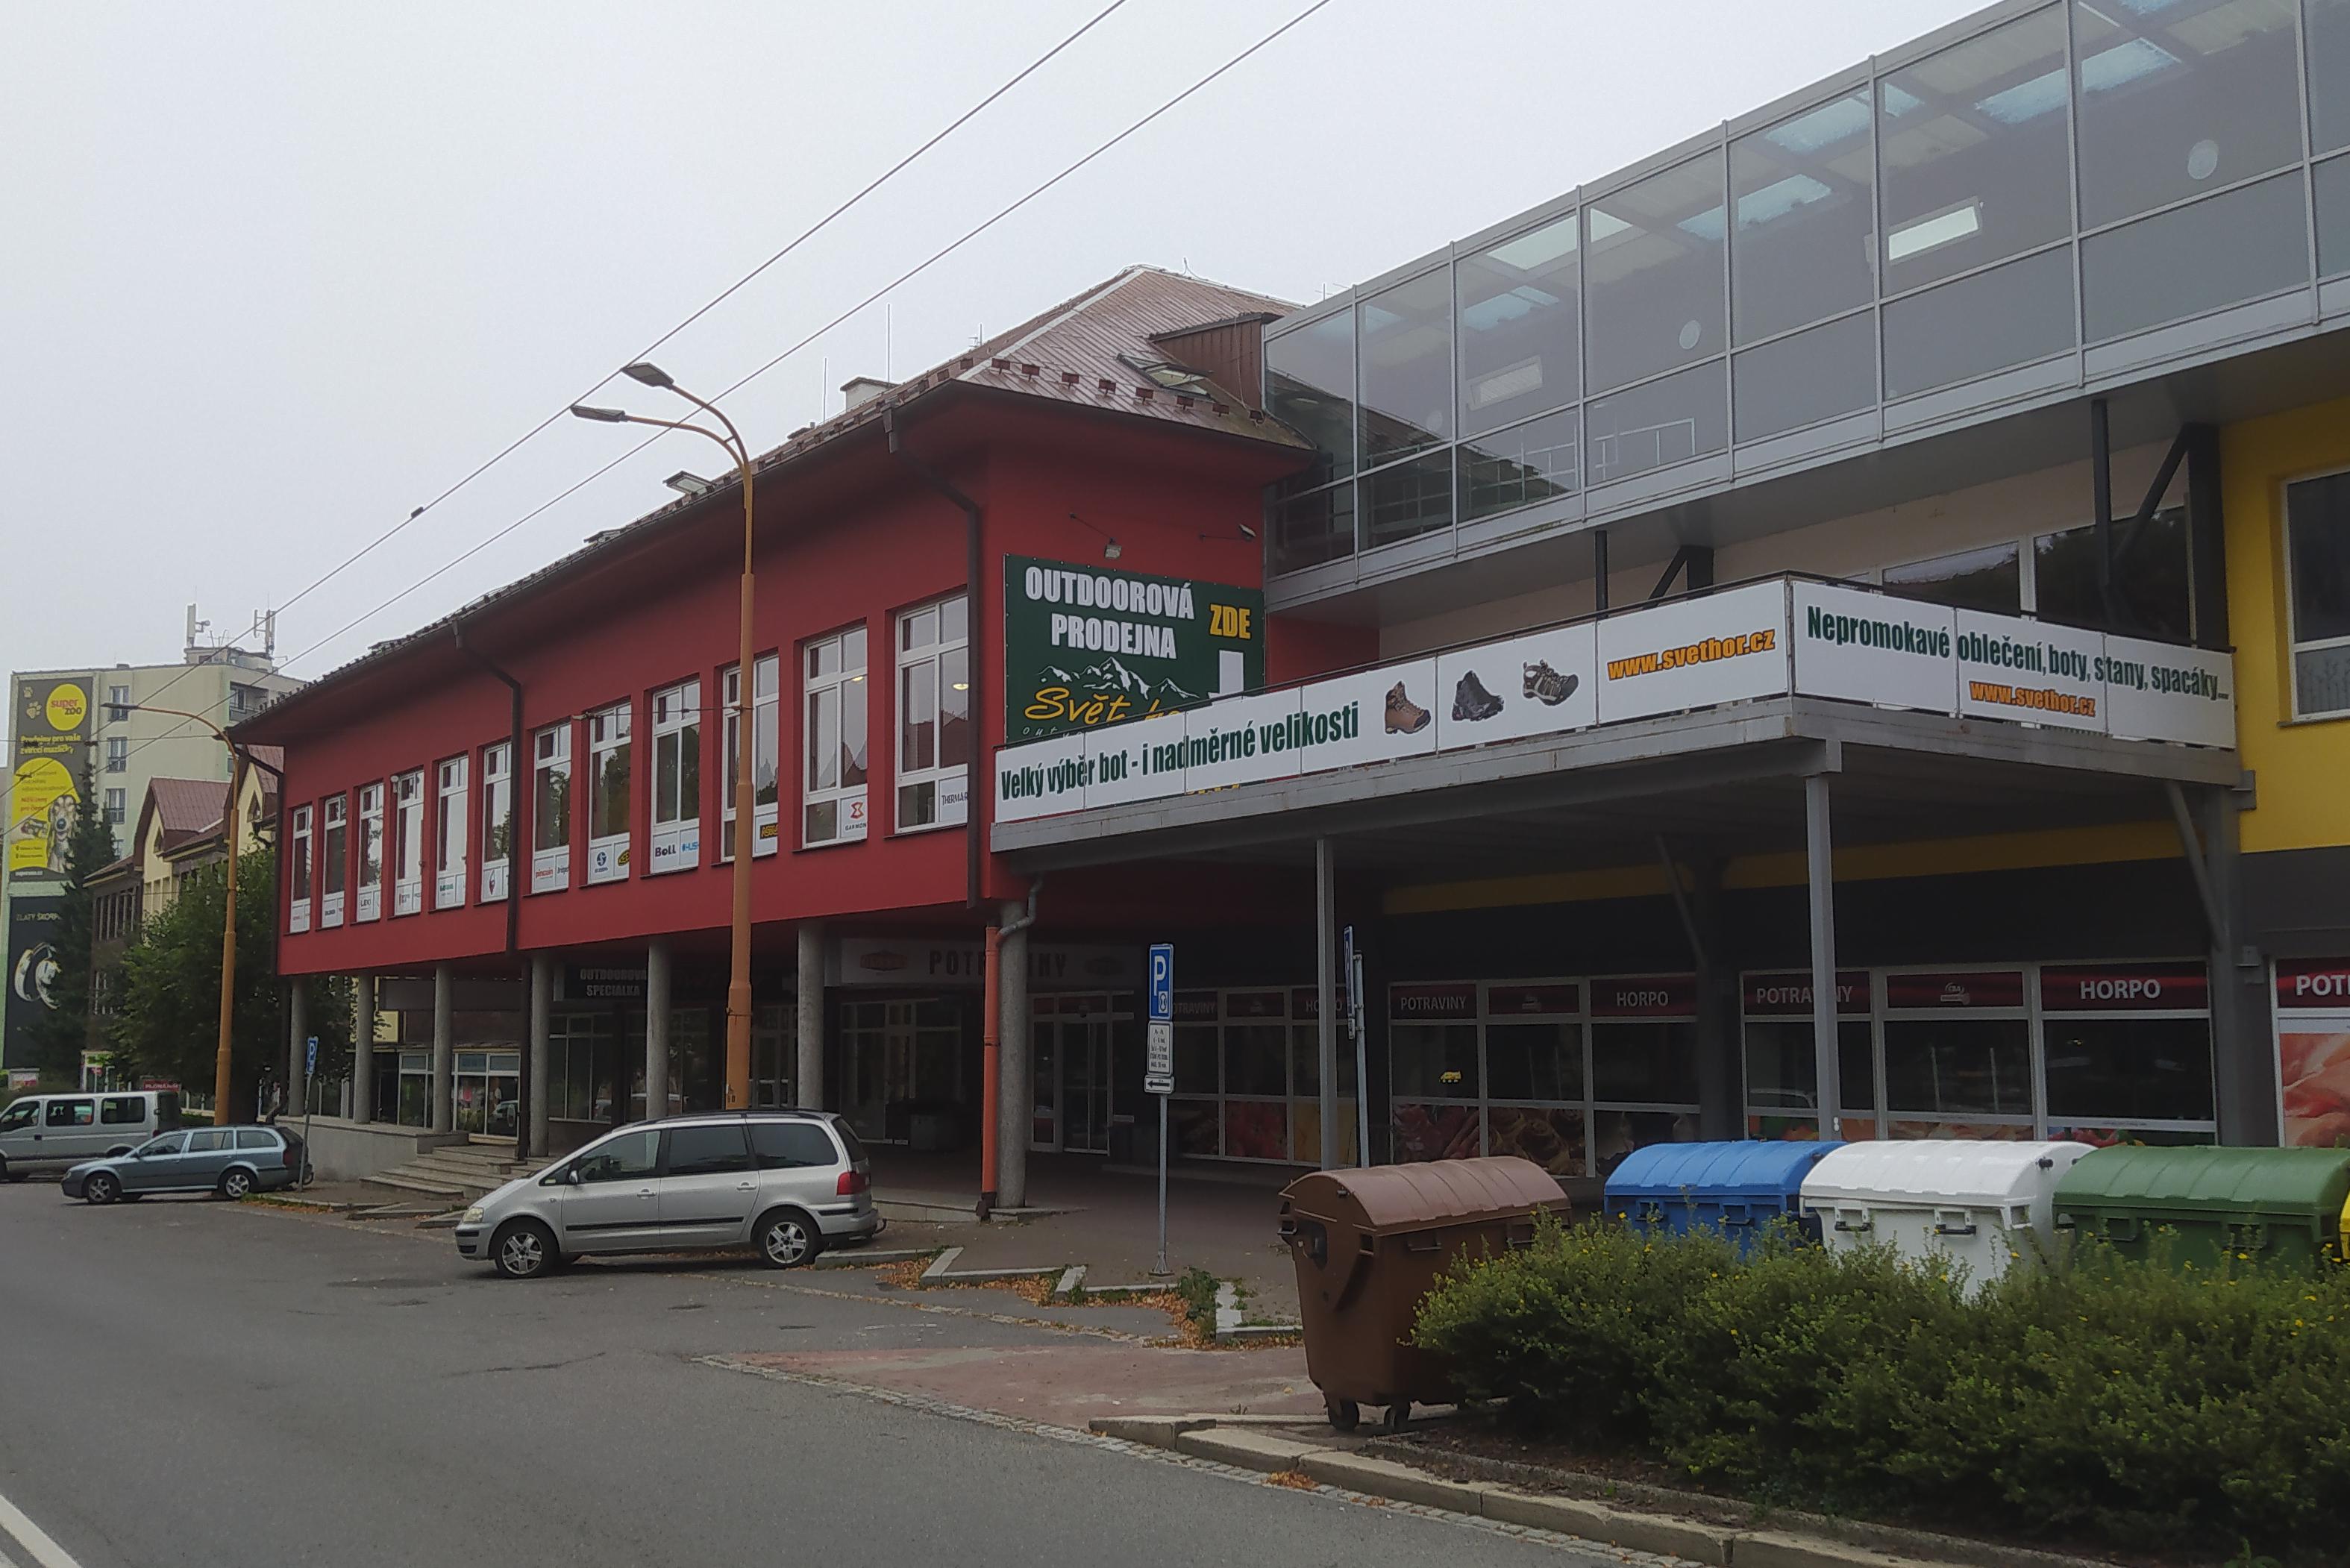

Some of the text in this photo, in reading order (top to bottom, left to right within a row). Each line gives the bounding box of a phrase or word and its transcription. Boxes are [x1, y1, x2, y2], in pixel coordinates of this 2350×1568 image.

[1025, 565, 1194, 620] OUTDOOROVÁ
[1050, 613, 1176, 660] PRODEJNA
[1209, 603, 1252, 640] ZDE
[1606, 627, 1776, 682] www.svethor.cz
[1807, 605, 1951, 659] Nepromokavé
[1958, 631, 2046, 677] oblečení,
[2047, 644, 2092, 683] boty,
[2093, 652, 2150, 692] stany,
[50, 698, 78, 708] super
[64, 706, 83, 715] zoo
[1024, 686, 1131, 727] Svět
[1968, 680, 2096, 718] www.svethor.cz
[1000, 761, 1045, 801] Velký
[1046, 747, 1096, 794] výběr
[1098, 750, 1128, 785] bot
[1141, 743, 1149, 777] i
[1153, 719, 1256, 775] nadměrné
[1259, 700, 1359, 755] velikosti
[655, 844, 677, 857] Boll
[929, 949, 1067, 978] POTRINY
[1154, 955, 1166, 997] P
[1616, 991, 1670, 1008] HORPO
[2079, 979, 2162, 1000] HORPO
[2296, 974, 2350, 997] POT
[1305, 999, 1343, 1013] HOO
[1400, 996, 1467, 1010] POTRAVINY
